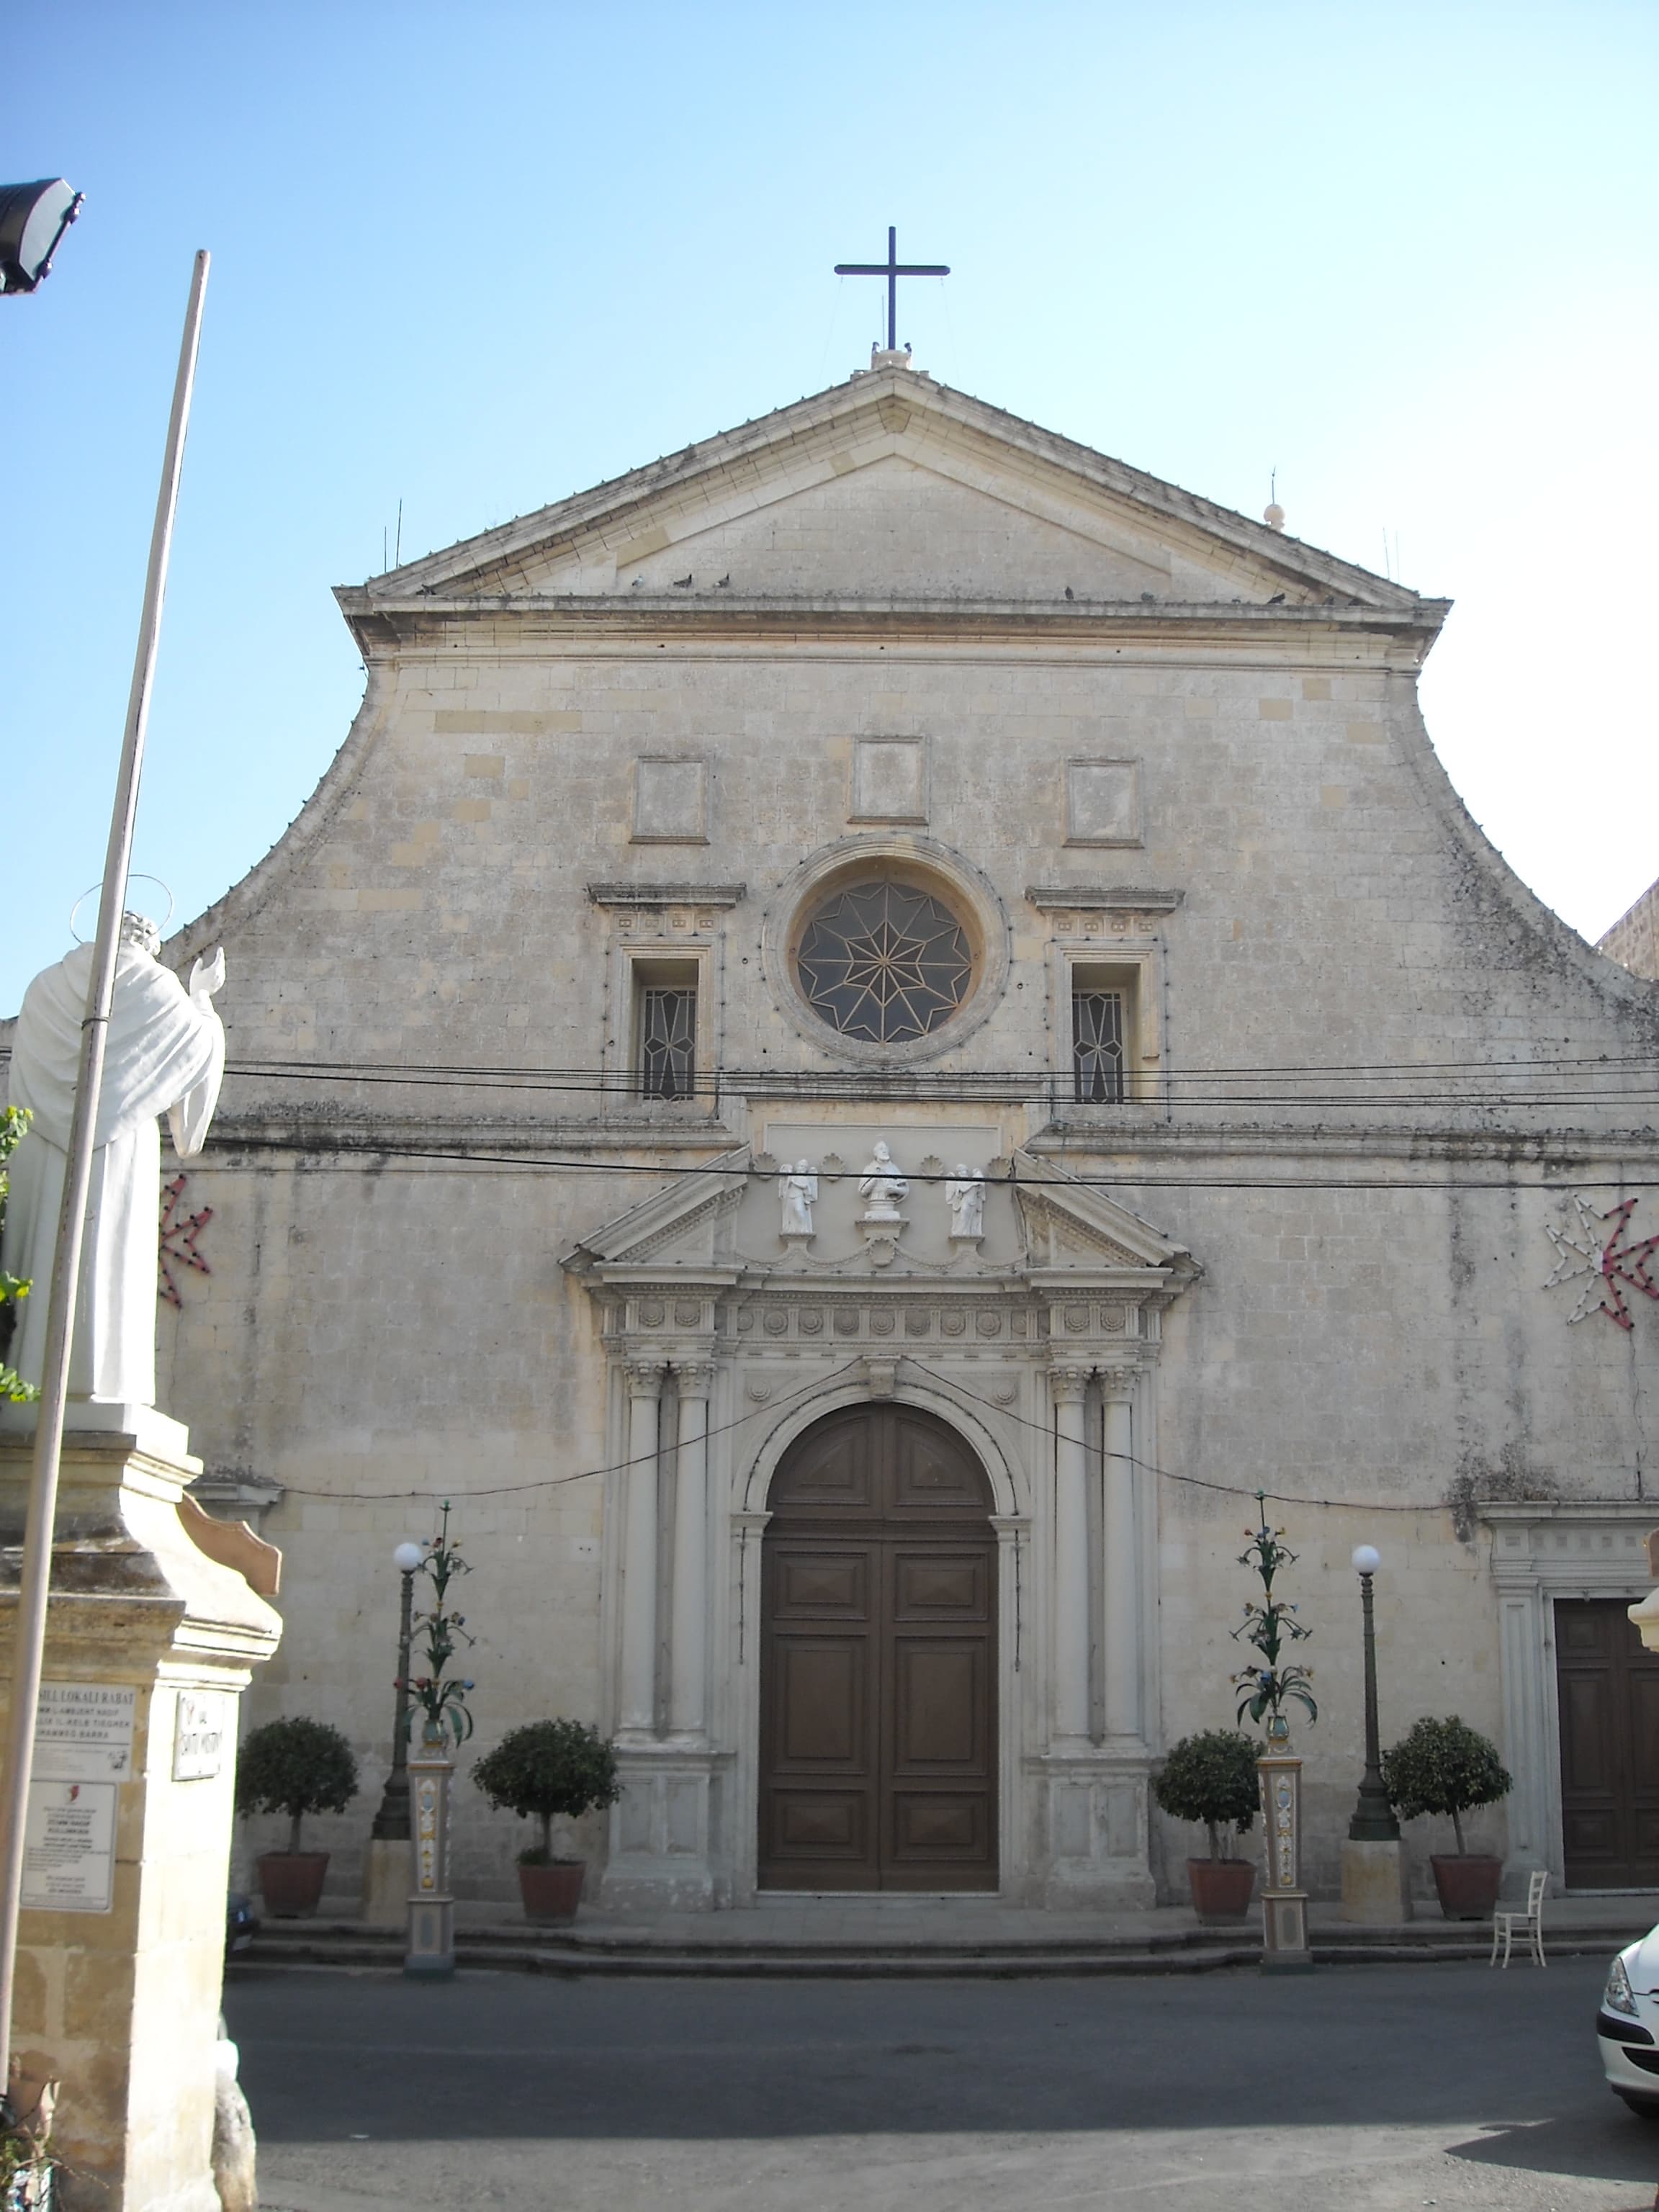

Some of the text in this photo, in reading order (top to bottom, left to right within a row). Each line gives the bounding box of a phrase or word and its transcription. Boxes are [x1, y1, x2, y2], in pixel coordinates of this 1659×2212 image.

[61, 1691, 99, 1704] LOKALI
[102, 1692, 134, 1705] RABAT
[79, 1730, 109, 1739] BARRA
